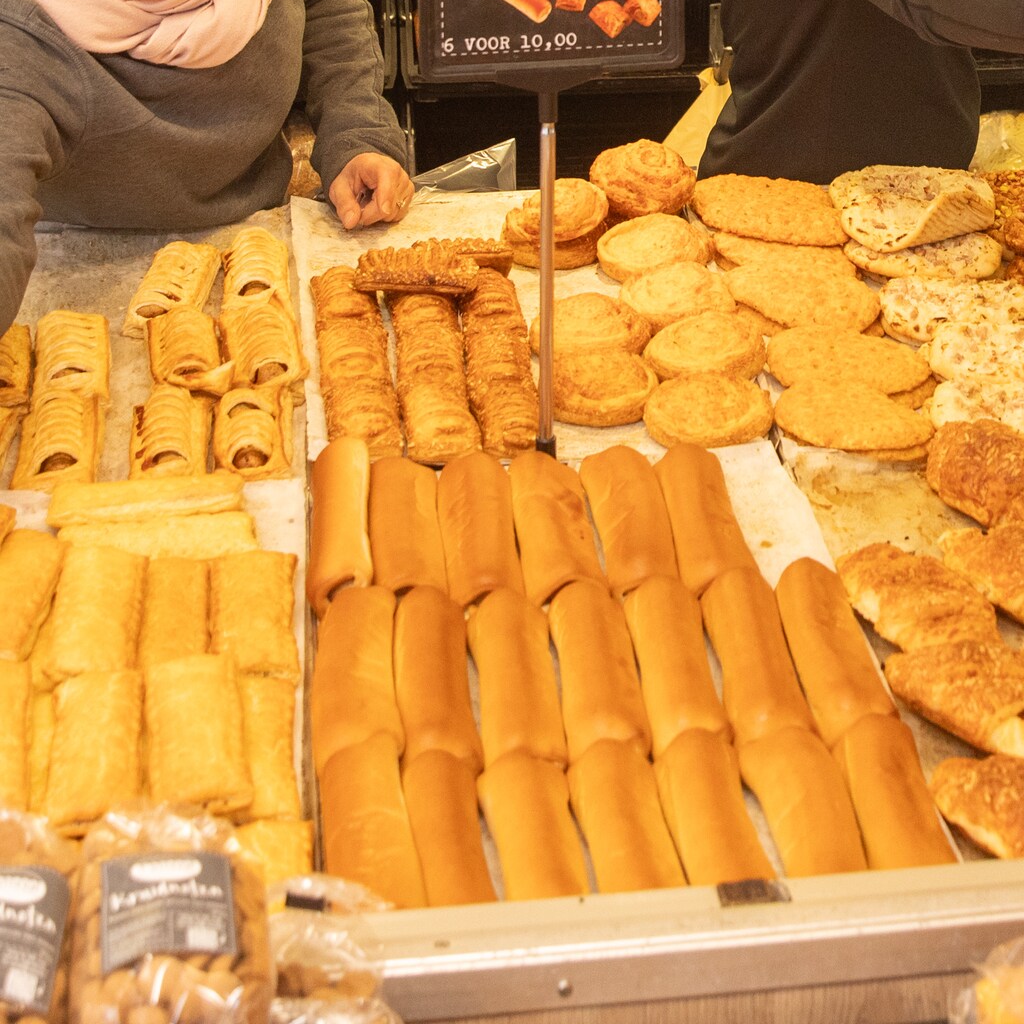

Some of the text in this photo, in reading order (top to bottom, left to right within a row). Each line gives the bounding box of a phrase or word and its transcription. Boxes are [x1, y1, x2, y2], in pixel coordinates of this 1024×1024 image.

[443, 32, 578, 54] 6 VOOR 10,00
